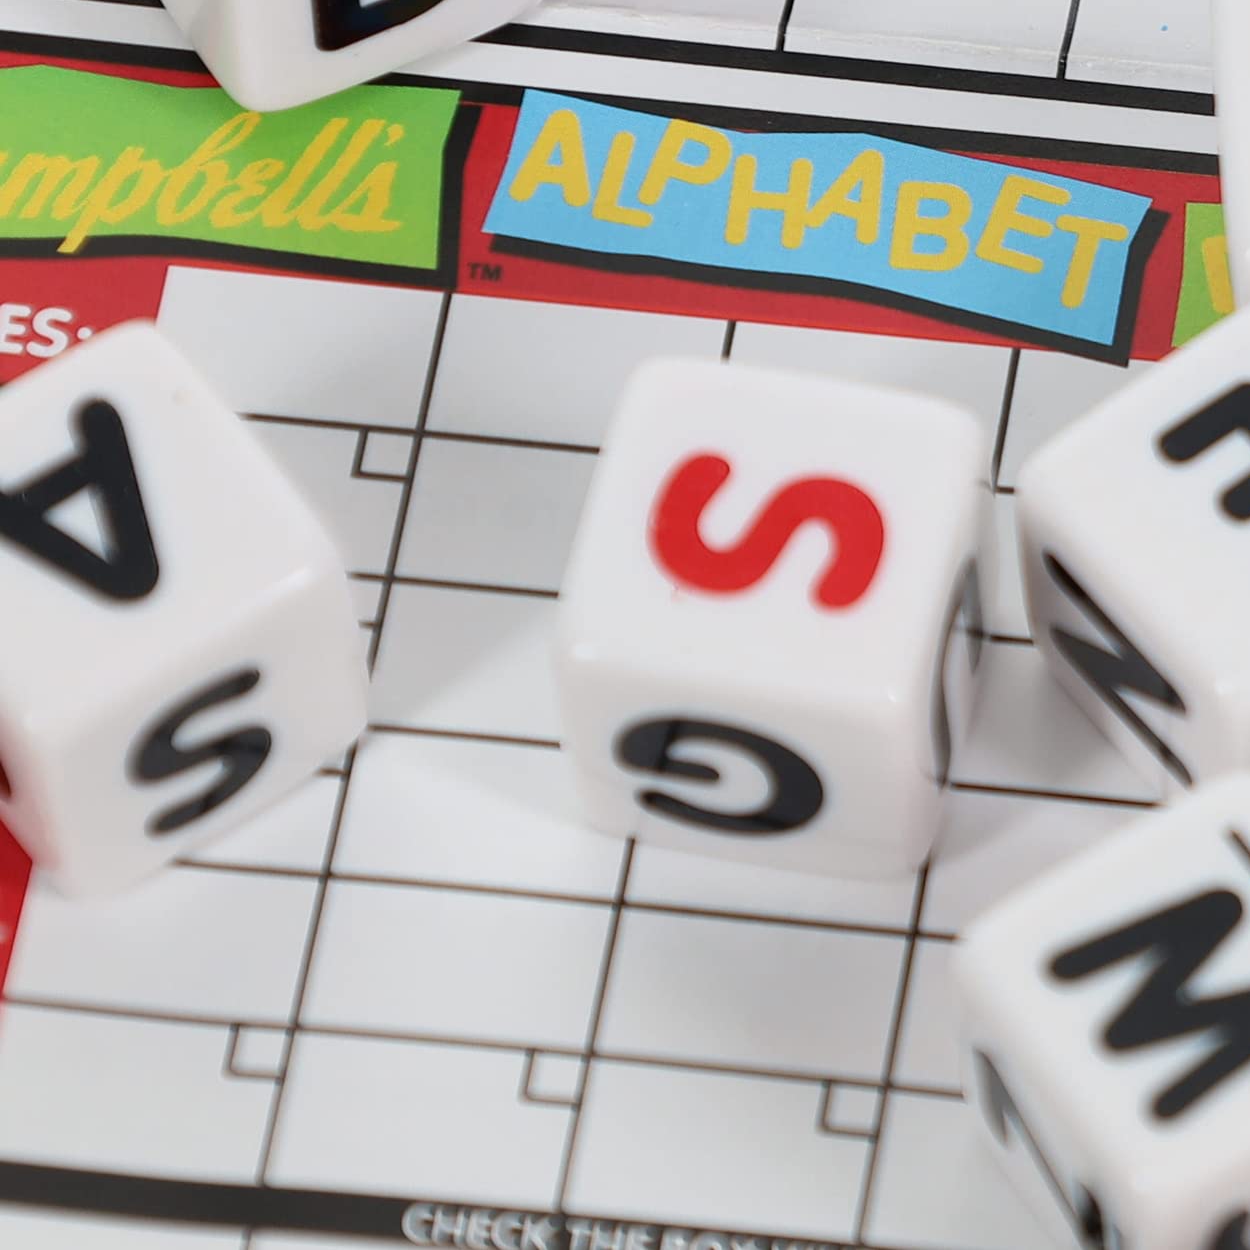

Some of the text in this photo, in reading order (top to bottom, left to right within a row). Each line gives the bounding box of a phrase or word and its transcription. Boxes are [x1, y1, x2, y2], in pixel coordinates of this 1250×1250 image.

[0, 111, 404, 253] mpbell's
[508, 108, 1129, 309] ALPHABET
[0, 398, 160, 603] A
[649, 452, 885, 612] S
[125, 666, 272, 838] S
[401, 1203, 548, 1250] CHECK
